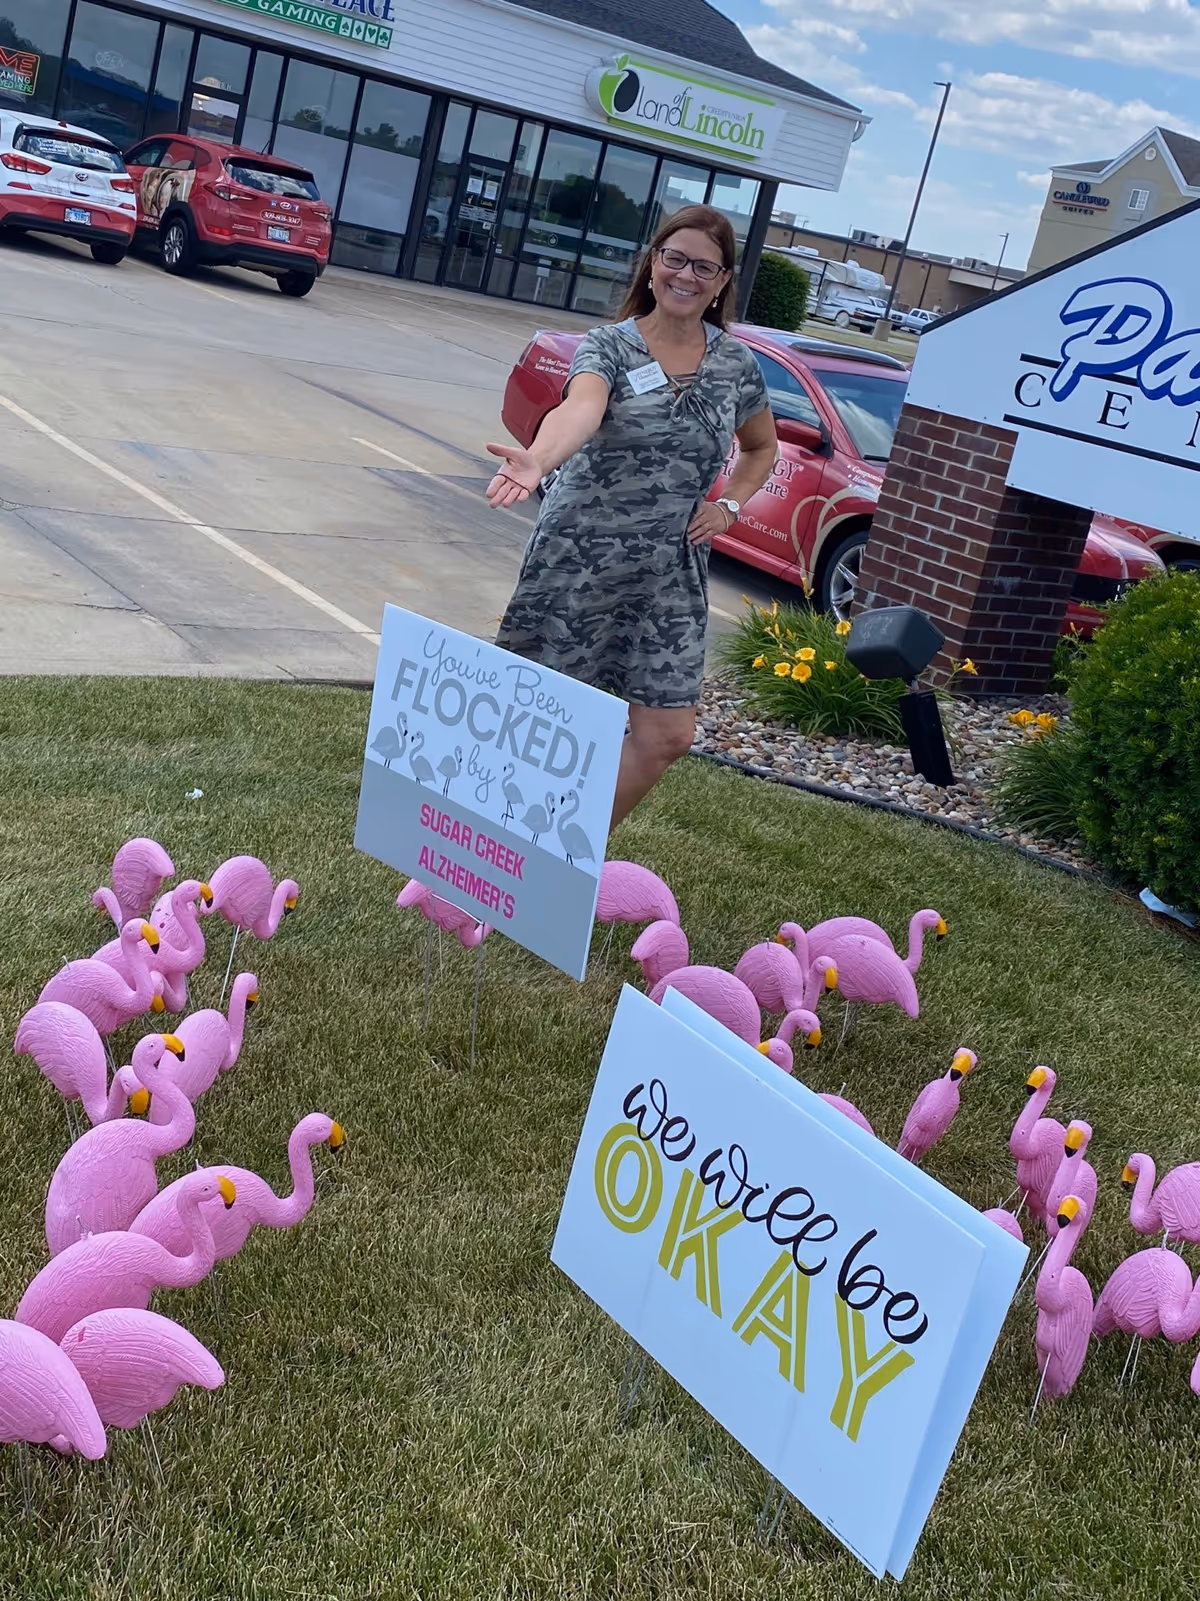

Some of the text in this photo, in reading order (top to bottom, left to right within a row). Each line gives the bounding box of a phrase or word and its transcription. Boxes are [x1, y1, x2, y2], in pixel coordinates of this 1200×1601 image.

[257, 0, 338, 30] GAMING
[636, 85, 765, 150] Land of Lincoln
[423, 629, 573, 725] You've Been
[391, 657, 597, 790] FLOCKED!
[467, 743, 497, 803] by
[419, 803, 526, 882] SUGAR CREEK
[418, 845, 517, 921] ALZHEIMER'S
[593, 1121, 916, 1444] OKAY
[699, 1142, 839, 1276] will
[836, 1228, 929, 1345] be
